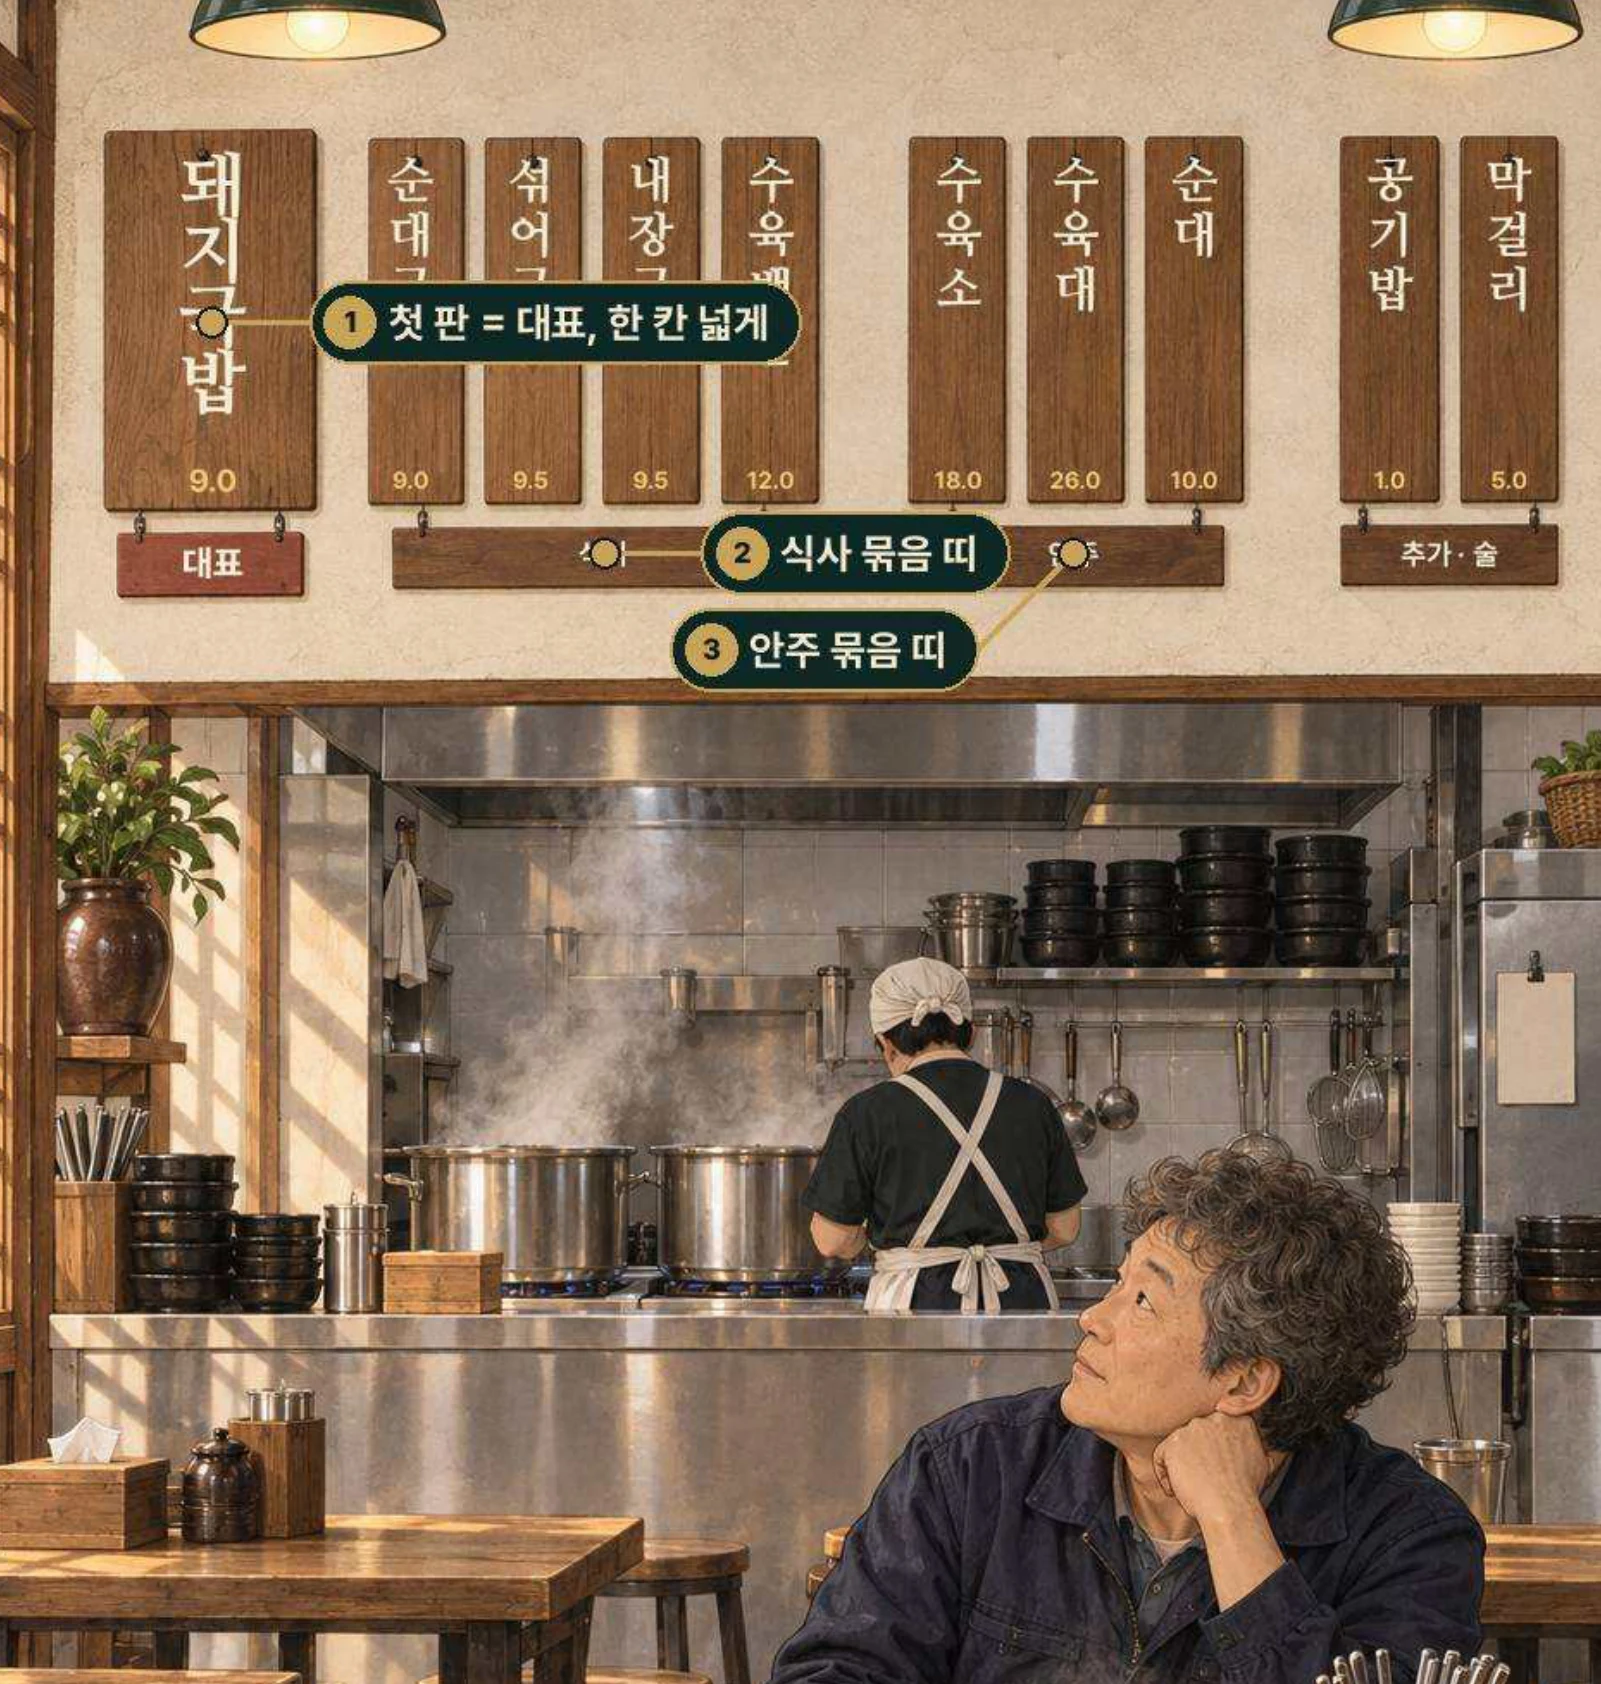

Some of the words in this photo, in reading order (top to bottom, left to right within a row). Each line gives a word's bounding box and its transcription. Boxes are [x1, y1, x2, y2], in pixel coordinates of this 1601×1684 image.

[387, 156, 435, 280] 순대
[509, 156, 549, 280] 섞어
[629, 155, 675, 280] 내장
[1171, 156, 1219, 258] 순대
[936, 156, 983, 307] 수육소
[1053, 156, 1100, 313] 수육대
[1367, 156, 1414, 312] 공기밥
[1487, 157, 1533, 313] 막걸리
[188, 468, 237, 494] 9.0
[392, 470, 430, 491] 9.0
[512, 469, 549, 491] 9.5
[632, 470, 669, 491] 9.5
[746, 469, 795, 491] 12.0
[934, 470, 983, 491] 18.0
[1050, 470, 1101, 491] 26.0
[1170, 470, 1219, 491] 10.0
[1373, 470, 1406, 490] 1.0
[1491, 470, 1528, 491] 5.0
[182, 546, 244, 580] 대표
[1401, 540, 1453, 568] 추가
[1473, 540, 1498, 568] 술
